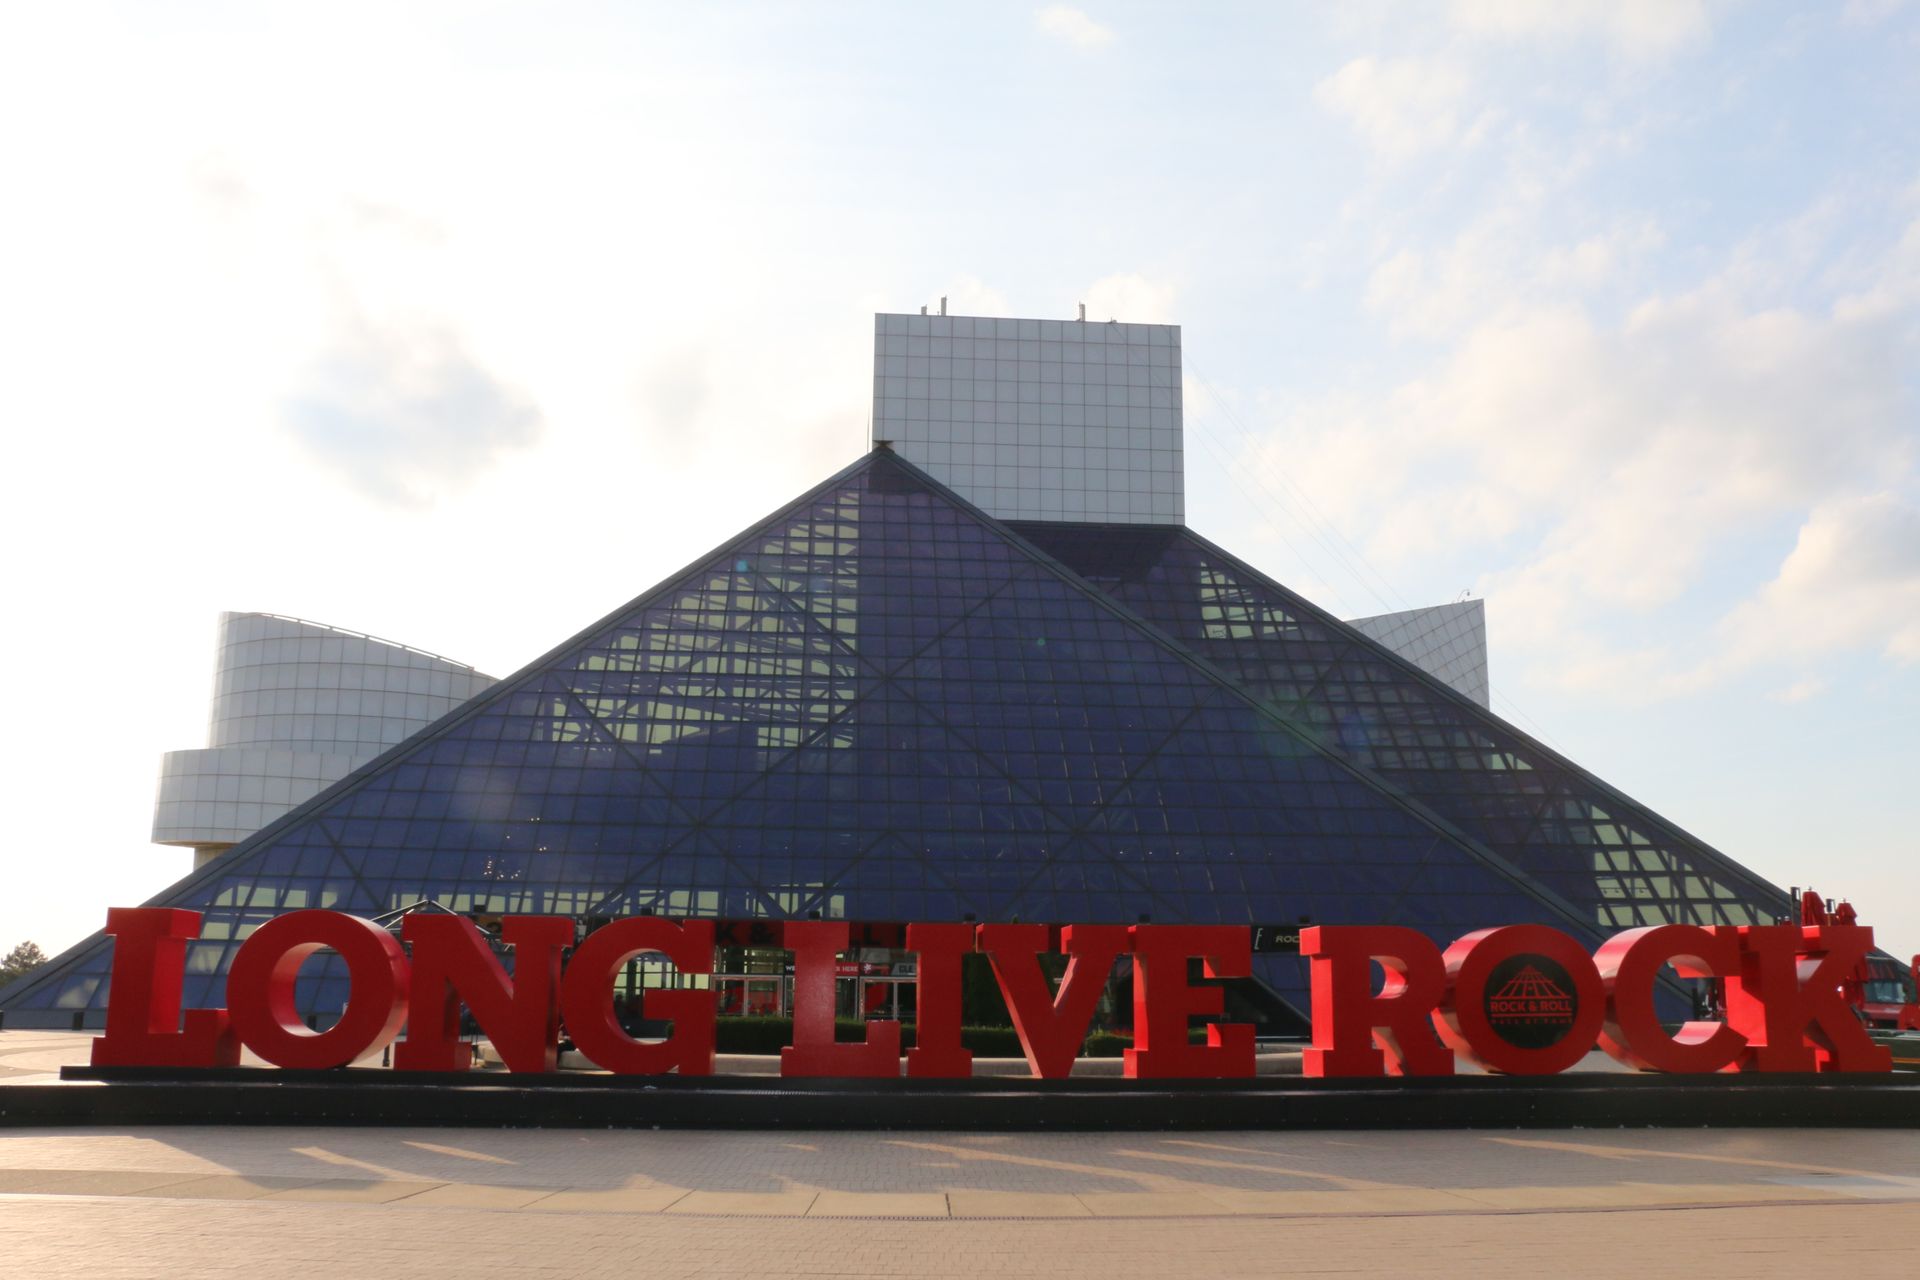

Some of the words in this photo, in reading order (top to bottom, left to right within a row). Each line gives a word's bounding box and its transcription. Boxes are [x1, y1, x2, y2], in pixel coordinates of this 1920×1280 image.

[1275, 935, 1300, 944] ROC
[91, 907, 716, 1075] LONG
[781, 920, 1256, 1078] LIVE
[1299, 924, 1892, 1077] ROCK
[1489, 1001, 1526, 1012] ROCK
[1528, 1001, 1538, 1012] &
[1539, 1001, 1572, 1012] ROLL
